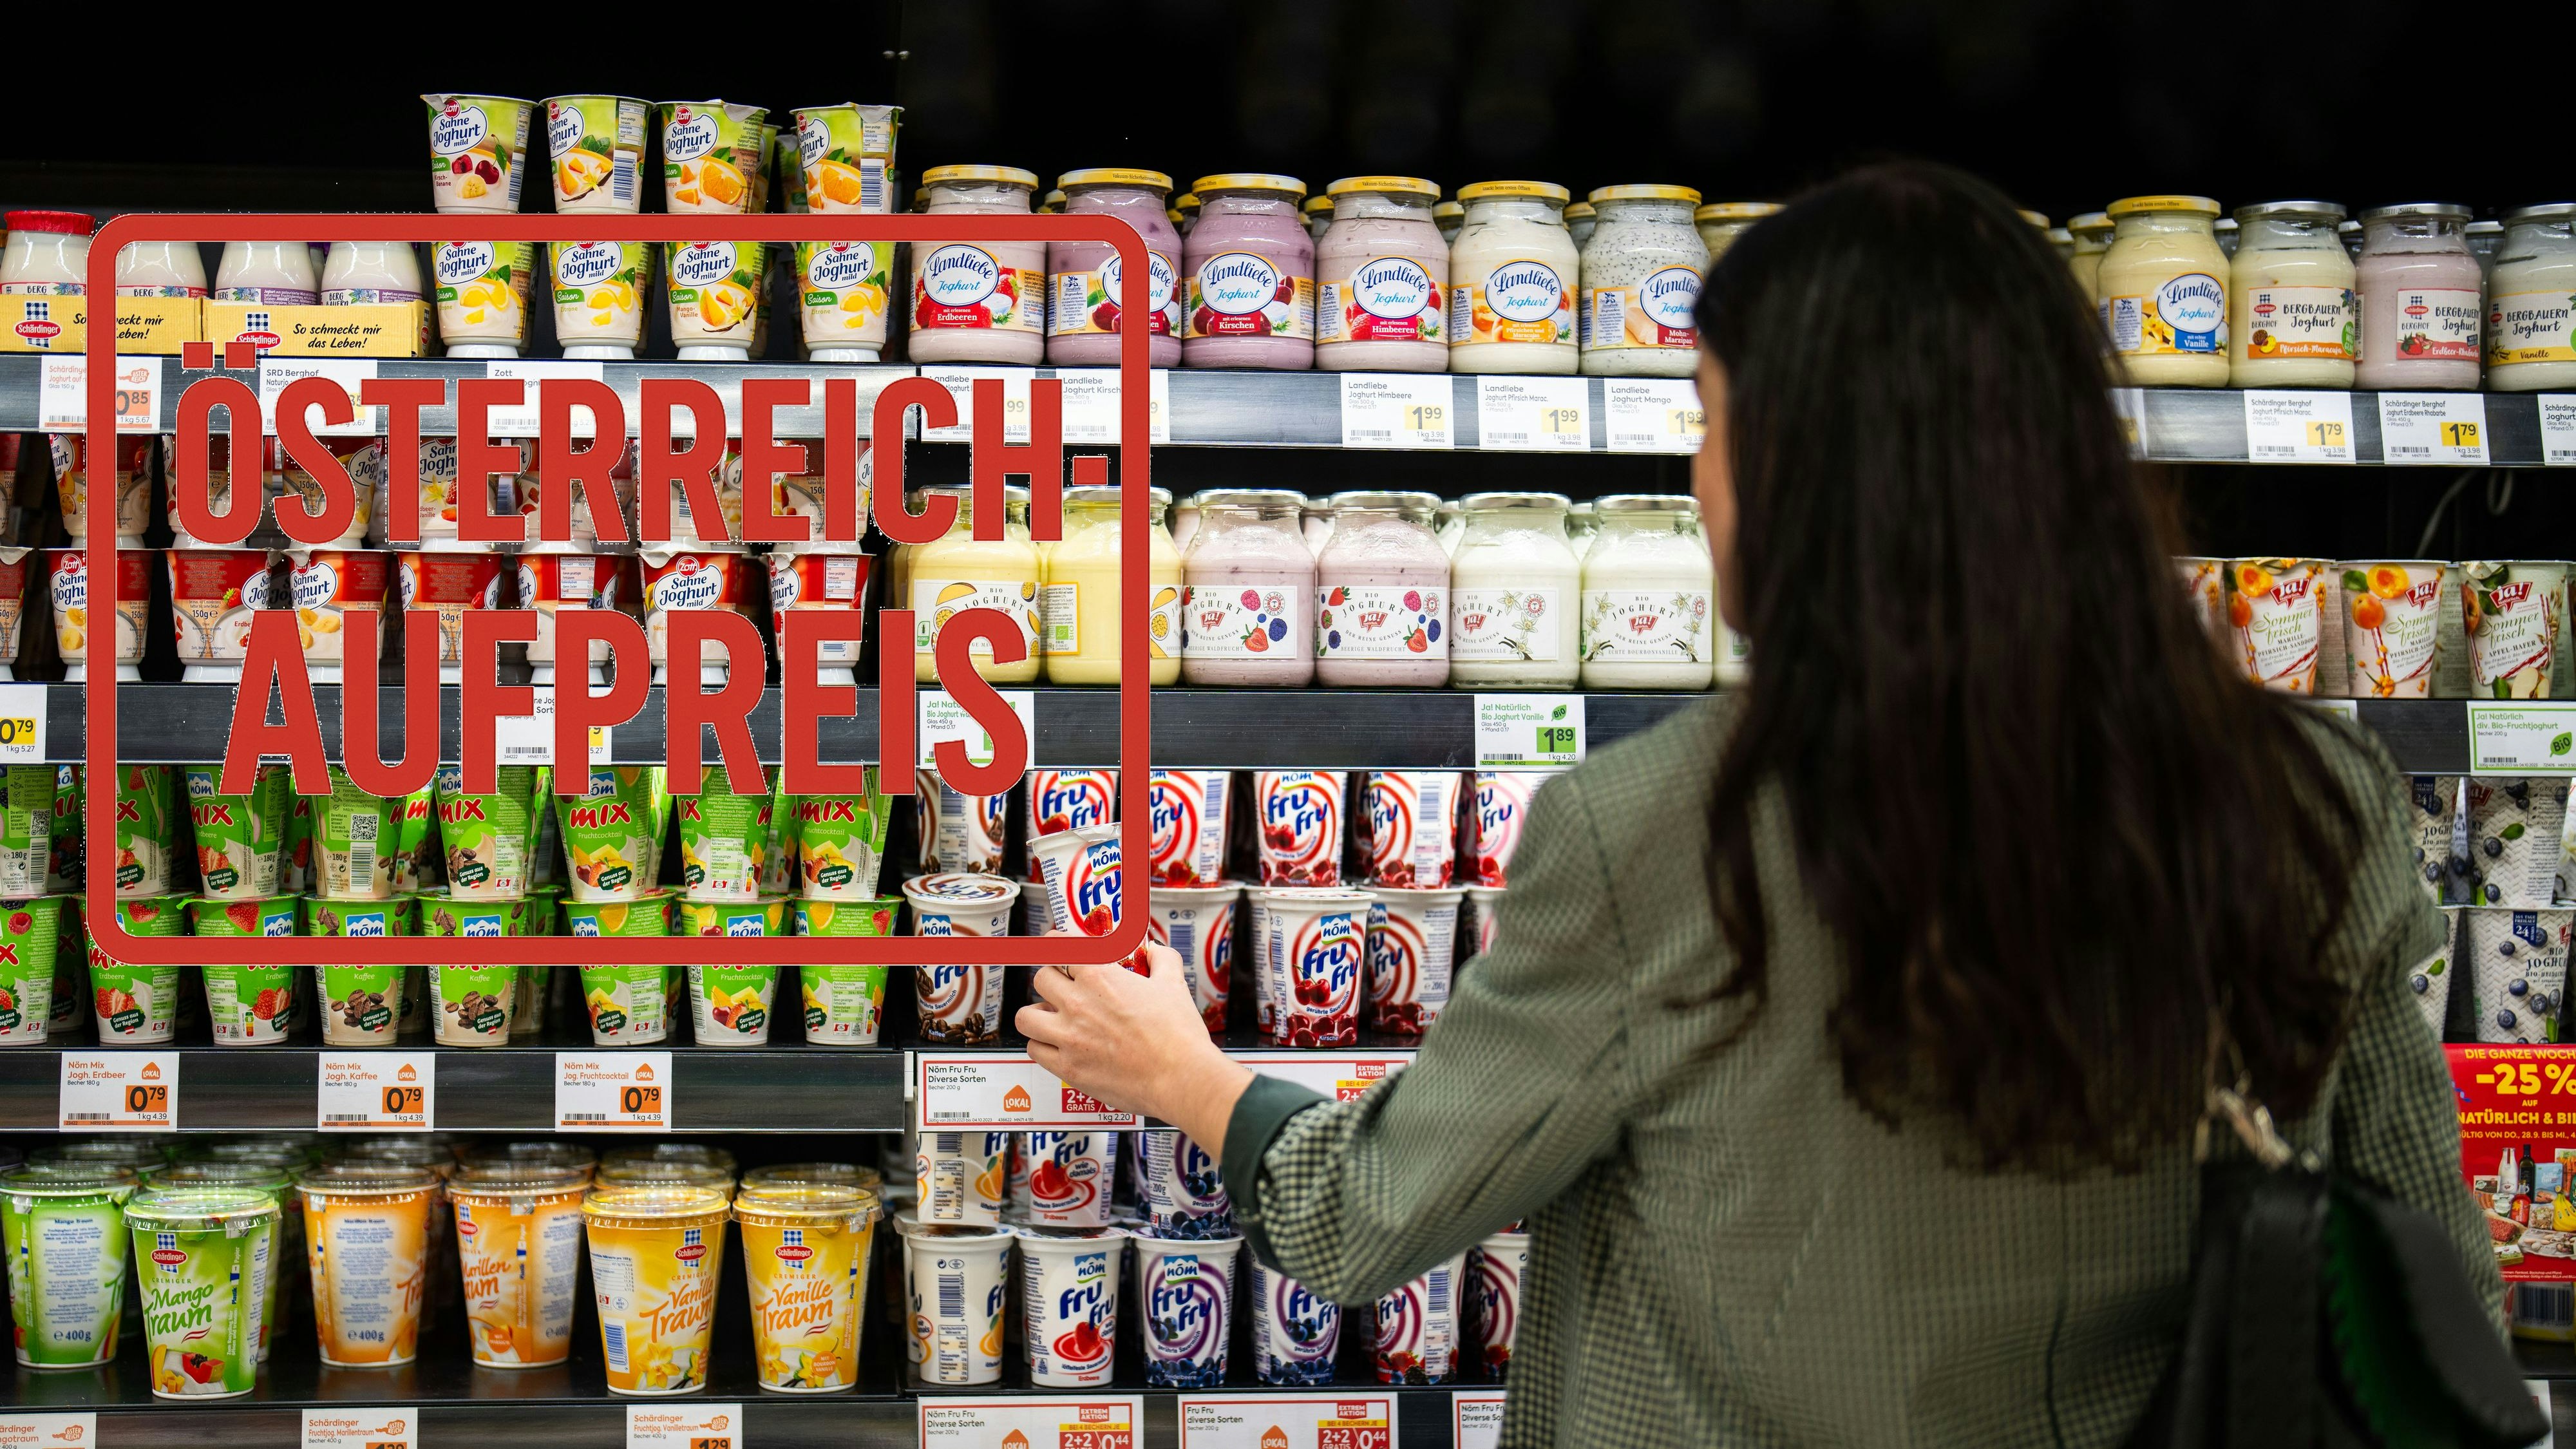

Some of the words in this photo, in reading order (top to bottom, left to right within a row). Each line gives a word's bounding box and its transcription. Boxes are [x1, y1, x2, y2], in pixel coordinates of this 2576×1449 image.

[440, 116, 469, 129] Sahne
[433, 125, 480, 147] Joghurt
[930, 247, 993, 281] Landliebe
[1207, 257, 1273, 290] Landliebe
[1362, 263, 1427, 294] Landliebe
[938, 278, 981, 293] Joghurt
[2167, 279, 2222, 310] Landliebe
[676, 306, 696, 314] Mango-
[1218, 321, 1255, 330] Kirschen
[2291, 316, 2336, 329] Joghurt
[18, 324, 59, 335] Schärdinger
[294, 324, 307, 335] So
[310, 324, 360, 335] schmeckt
[363, 324, 381, 335] mir
[1372, 325, 1415, 334] Himbeeren
[1668, 328, 1690, 337] Mohn-
[308, 338, 325, 348] das
[330, 338, 366, 348] Leben!
[1664, 336, 1692, 345] Marzipan
[2183, 339, 2210, 348] Vanille
[2520, 350, 2549, 359] Vanille
[266, 368, 283, 377] SRD
[285, 368, 319, 378] Berghof
[1348, 381, 1388, 390] Landliebe
[1348, 391, 1377, 401] Joghurt
[1378, 391, 1412, 399] Himbeere
[1484, 393, 1507, 403] Joghurt
[1507, 393, 1529, 402] Pfirsich
[2252, 408, 2271, 417] Joghurt
[2272, 408, 2292, 416] Pfirsich
[1342, 600, 1405, 618] JOGHURT
[1493, 702, 1531, 712] Natürlich
[1481, 712, 1492, 721] Bio
[1493, 713, 1519, 722] Joghurt
[1520, 712, 1544, 721] Vanille
[2489, 712, 2524, 721] Natürlich
[2476, 721, 2490, 730] div.
[2492, 722, 2558, 731] Bio-Fruchtjoghurt
[577, 829, 623, 839] Fruchtcocktail
[600, 873, 617, 882] Genuss
[611, 875, 627, 885] Region
[1306, 1006, 1328, 1015] gerührte
[1329, 990, 1350, 1015] Sauermilch
[2465, 1048, 2486, 1059] DIE
[2488, 1049, 2532, 1059] GANZE
[2533, 1049, 2576, 1059] WOCH
[68, 1060, 88, 1070] Nöm
[89, 1061, 105, 1070] Mix
[564, 1061, 584, 1070] Nöm
[585, 1061, 600, 1070] Mix
[927, 1065, 947, 1074] Nöm
[68, 1070, 90, 1080] Jogh.
[93, 1070, 126, 1079] Erdbeer
[142, 1070, 160, 1079] LOKAL
[325, 1072, 347, 1081] Jogh.
[350, 1072, 377, 1081] Kaffee
[580, 1071, 629, 1081] Fruchtcocktail
[1005, 1099, 1029, 1108] LOKAL
[1066, 1103, 1096, 1112] GRATIS
[1102, 1113, 1113, 1122] kg
[1114, 1113, 1131, 1121] 2.20
[2456, 1108, 2539, 1124] NATÜRLICH
[2543, 1112, 2553, 1124] &
[152, 1252, 186, 1262] Schärdinger
[775, 1248, 812, 1257] Schärdinger
[151, 1276, 192, 1285] CREMIGER
[773, 1272, 818, 1280] CREMIGER
[153, 1283, 213, 1309] Mango
[773, 1280, 833, 1307] Vanille
[145, 1303, 212, 1342] Traum
[755, 1299, 833, 1338] Traum
[1163, 1372, 1197, 1381] Heidelbeere
[308, 1419, 359, 1428] Schärdinger
[663, 1424, 699, 1432] Vanilletraum
[336, 1428, 374, 1437] Marillentraum
